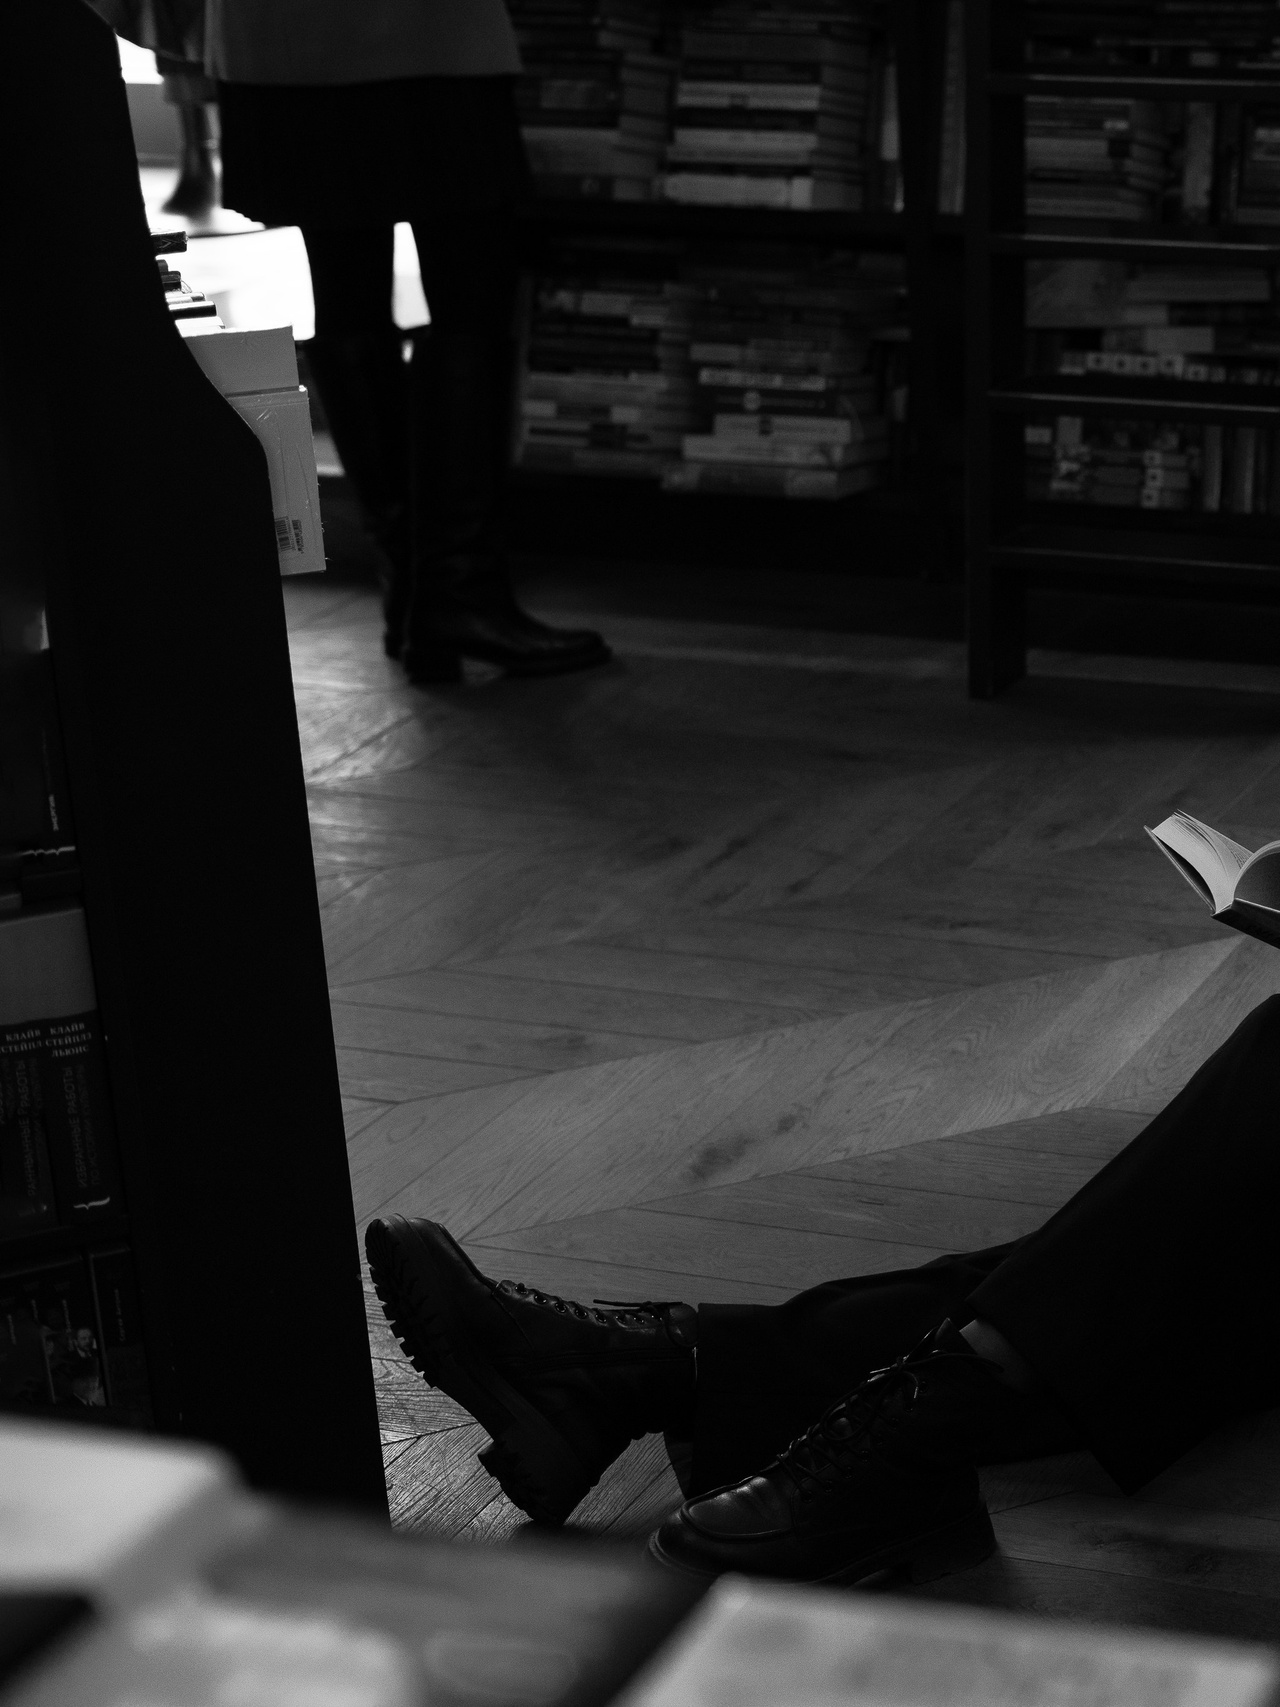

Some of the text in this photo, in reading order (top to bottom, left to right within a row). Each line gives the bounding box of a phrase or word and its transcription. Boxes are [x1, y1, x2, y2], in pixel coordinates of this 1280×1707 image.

[49, 1021, 86, 1036] КЛАЙВ
[44, 1030, 93, 1047] СТЕЙПЛЗ
[51, 1044, 89, 1058] ЛЬЮИС
[60, 1065, 89, 1188] ИЗБРАННЫЕ РАБОТЫ
